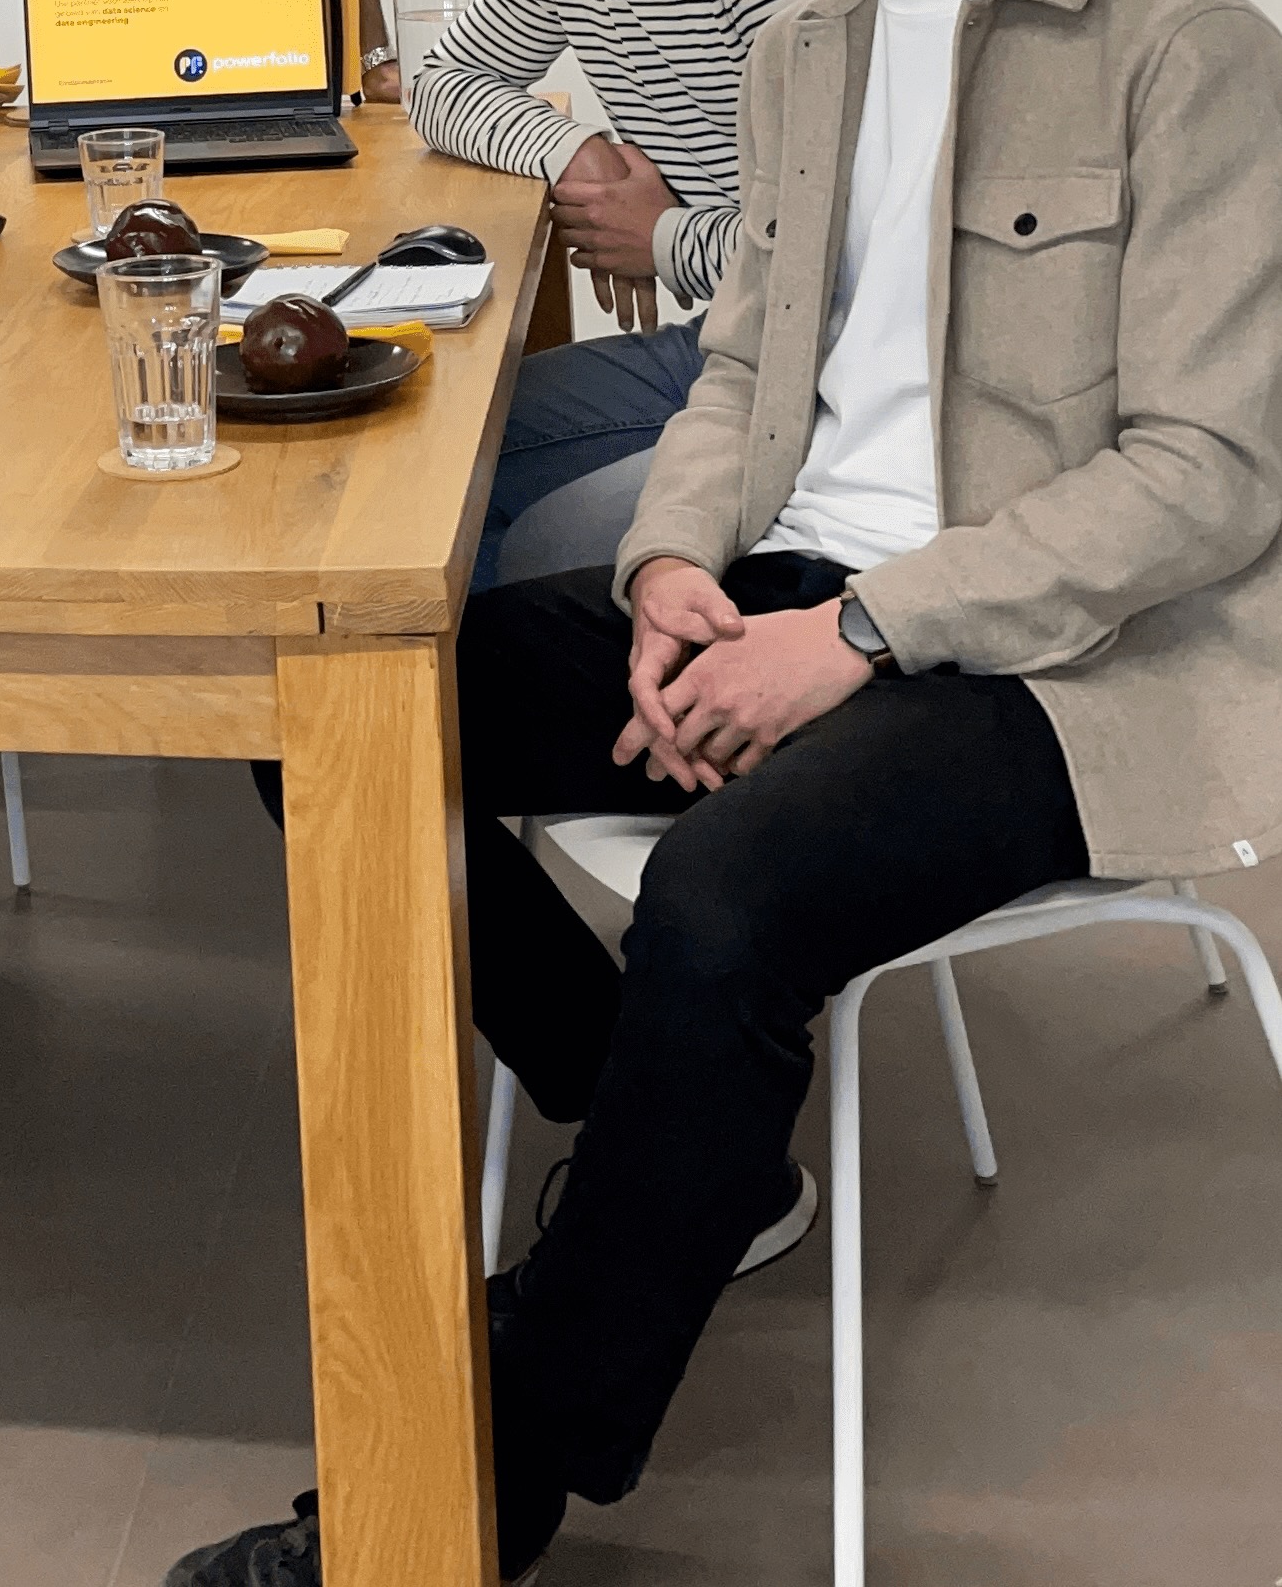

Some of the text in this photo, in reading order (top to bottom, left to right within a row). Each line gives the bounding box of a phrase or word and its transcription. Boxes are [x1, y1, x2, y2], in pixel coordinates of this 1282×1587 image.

[102, 7, 122, 15] data
[123, 5, 157, 14] science
[55, 17, 129, 27] data engineering
[212, 52, 310, 73] powerfolio
